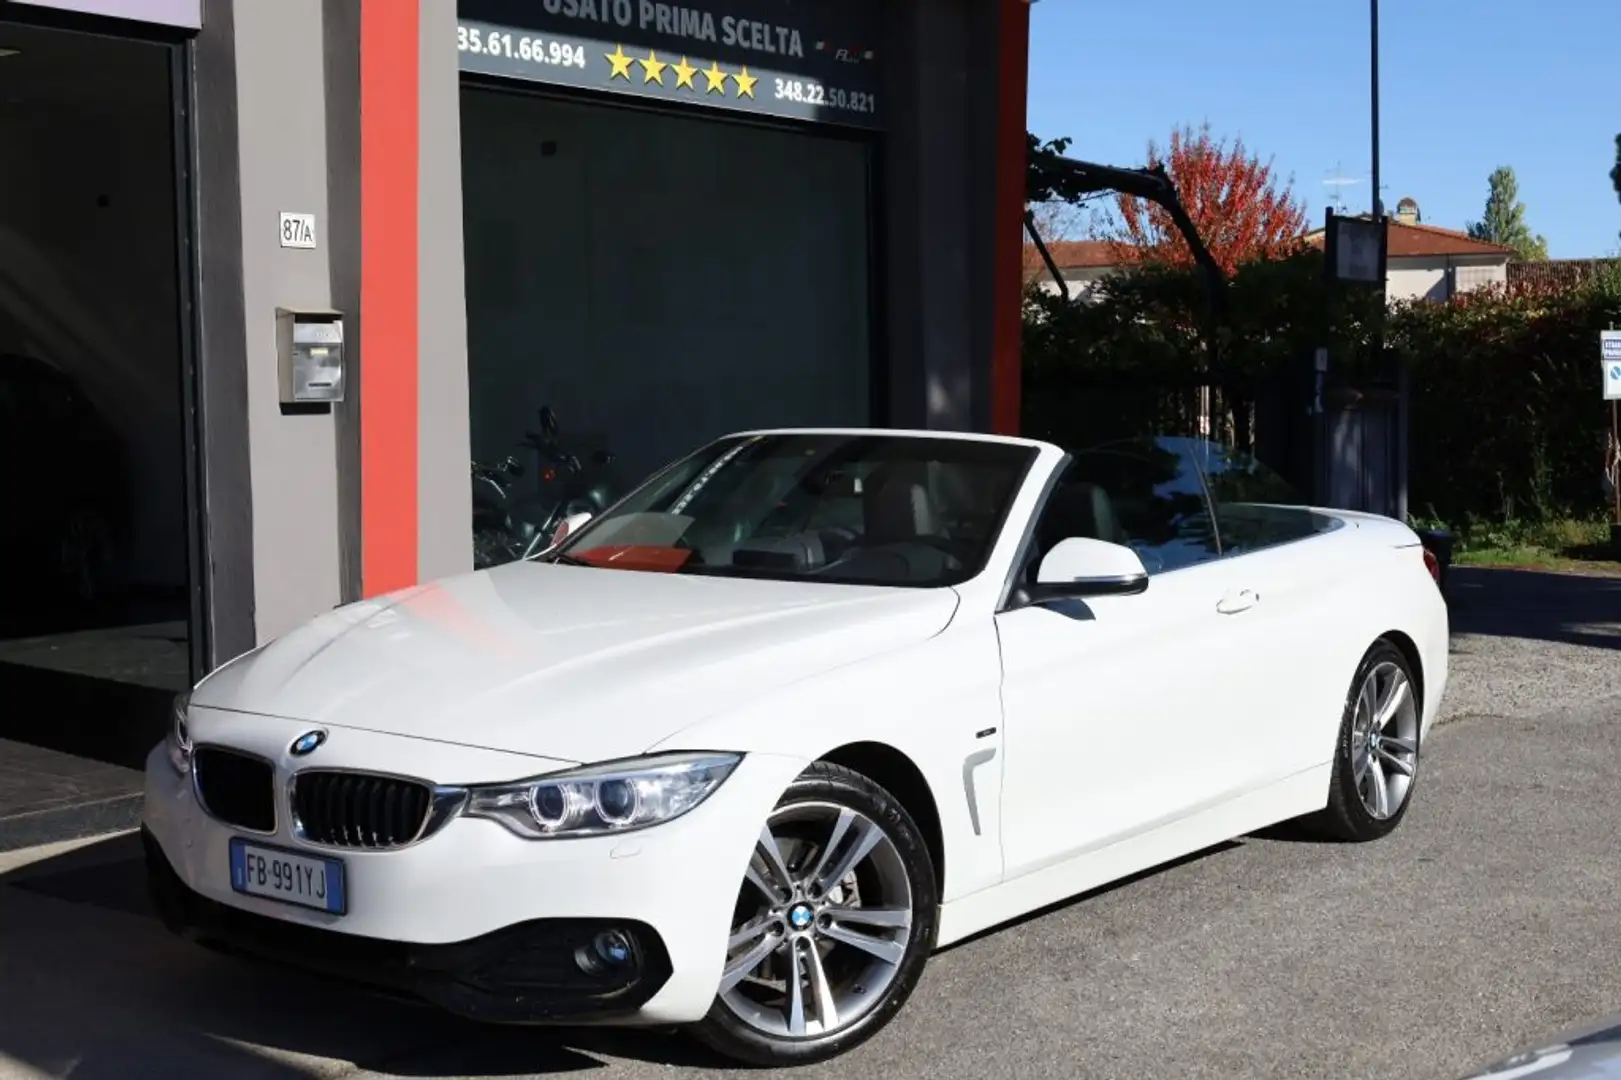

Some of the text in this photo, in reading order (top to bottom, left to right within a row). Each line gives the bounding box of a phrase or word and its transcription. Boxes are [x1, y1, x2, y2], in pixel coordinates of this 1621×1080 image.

[639, 0, 717, 43] PRIMA
[721, 15, 804, 58] SCELTA
[774, 77, 875, 114] 348.22.50.821
[283, 218, 313, 242] 87/A
